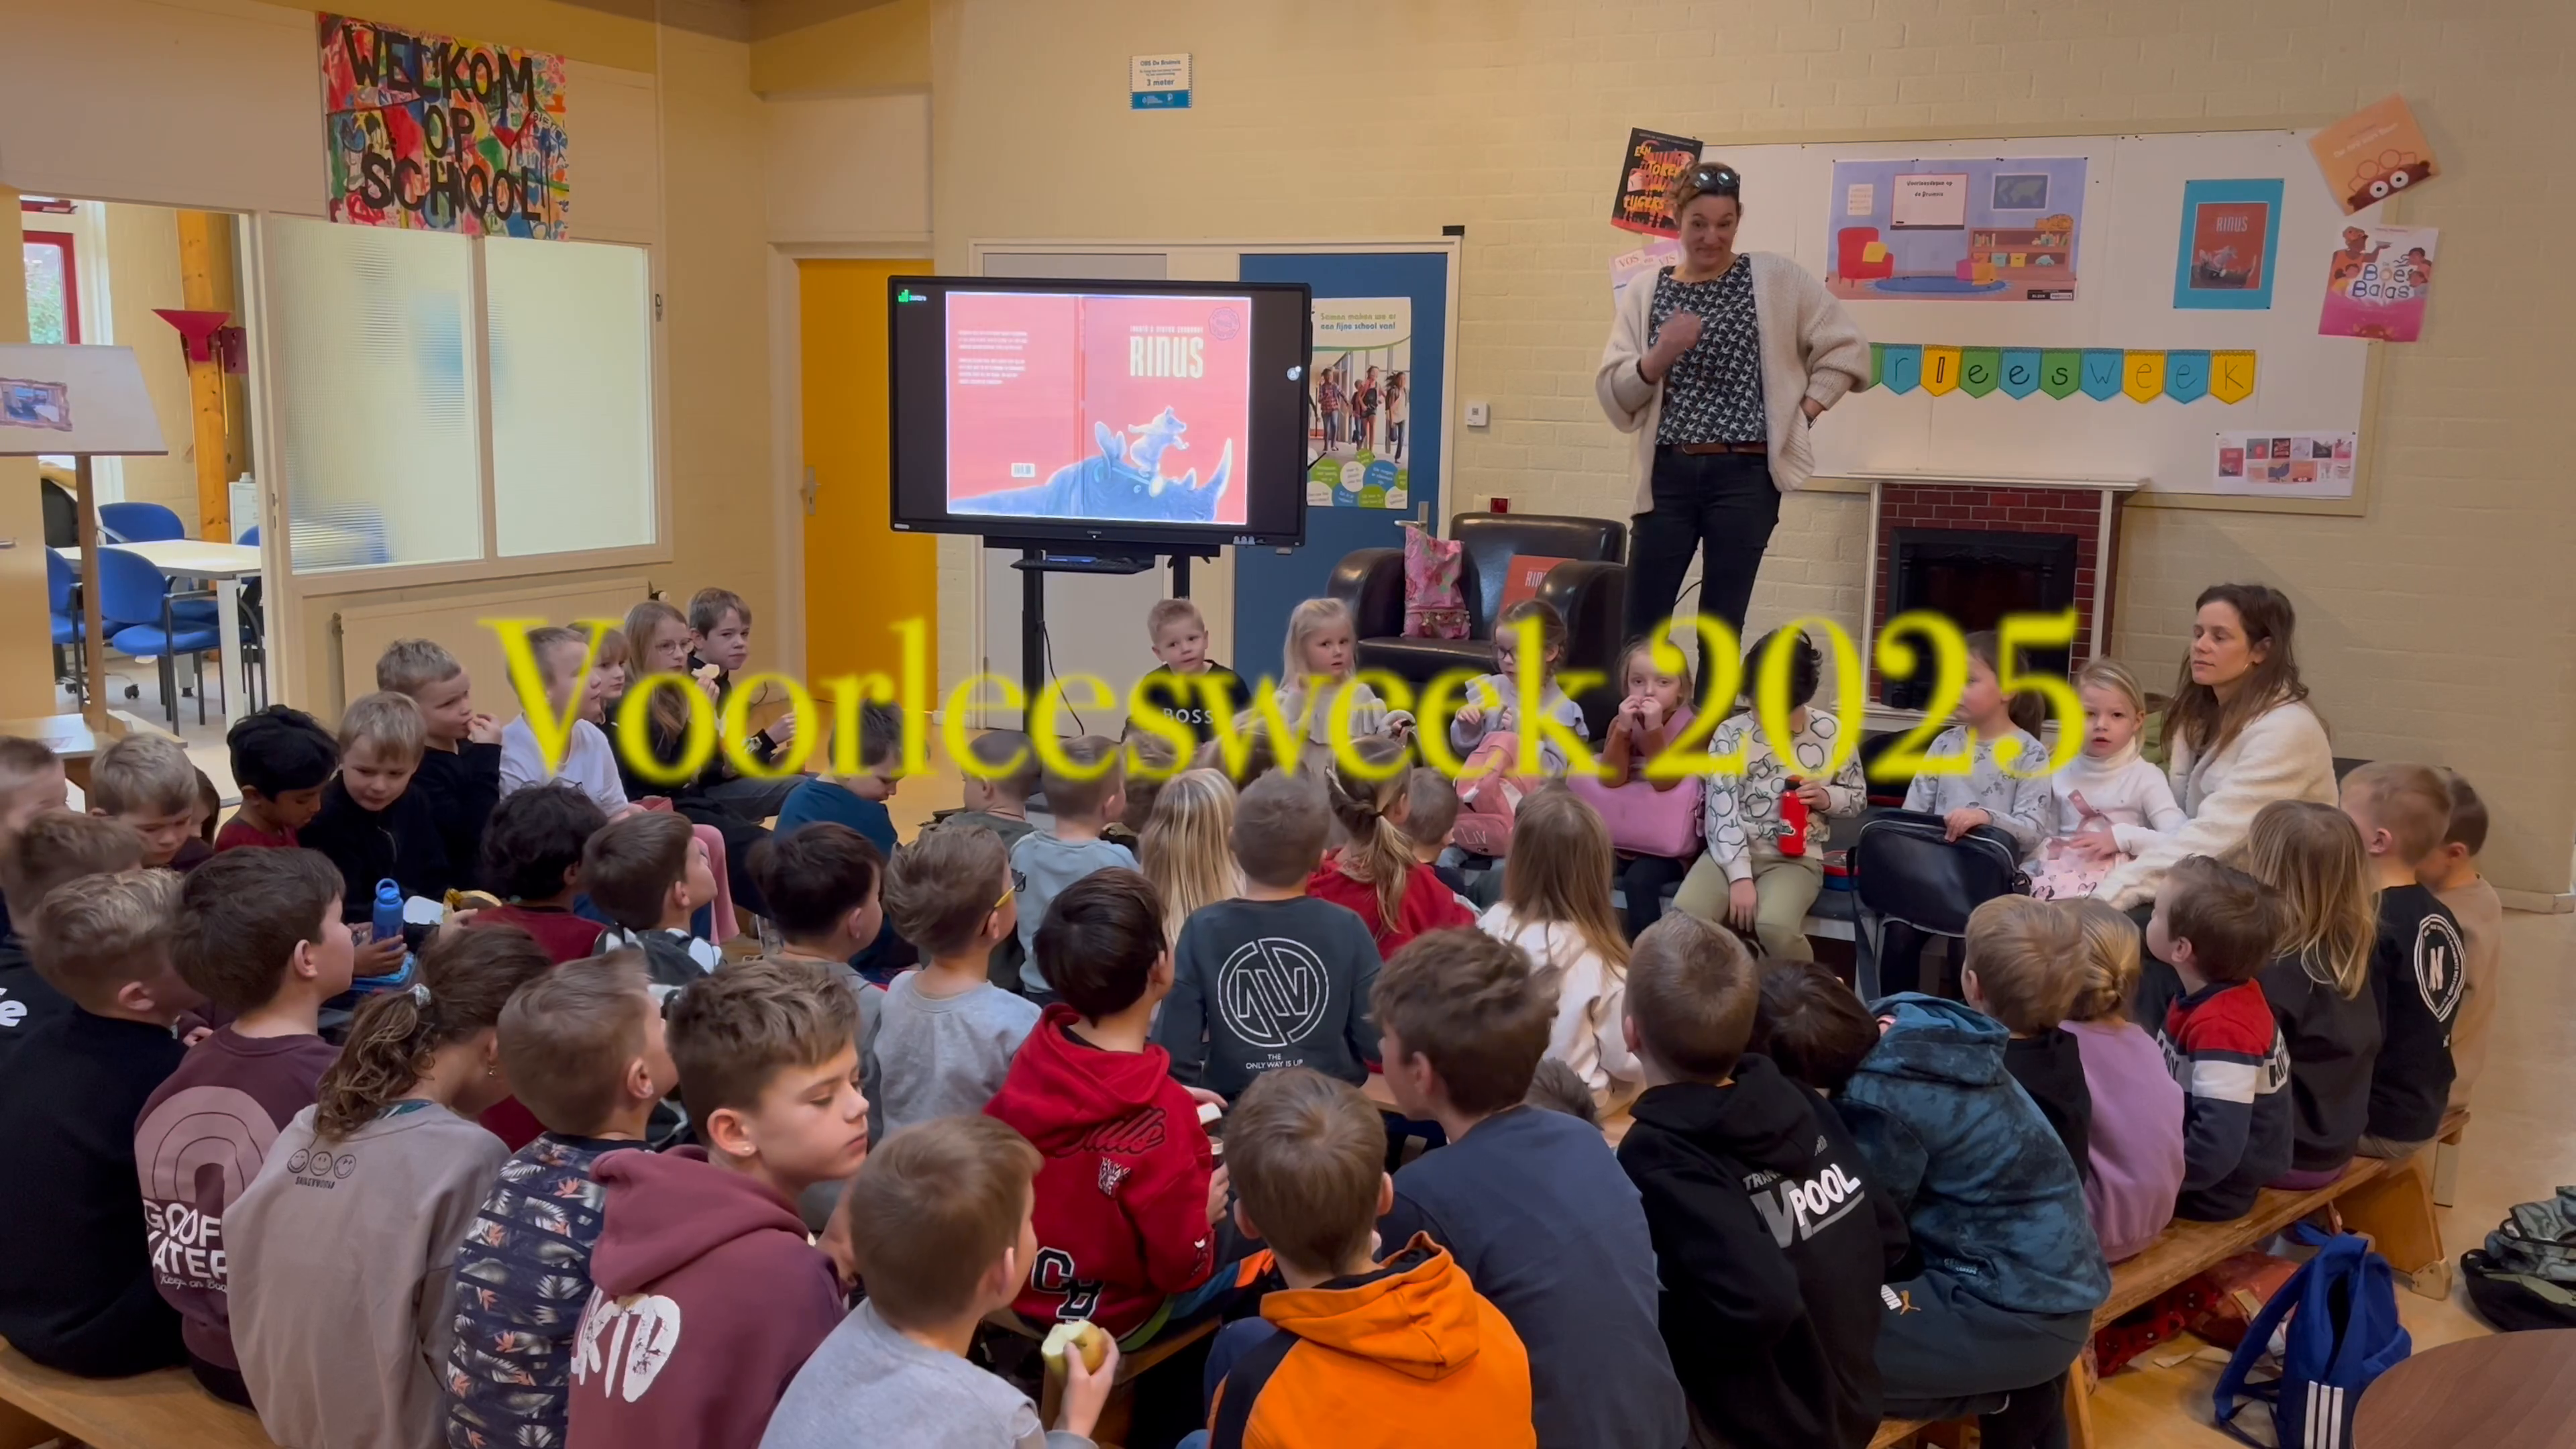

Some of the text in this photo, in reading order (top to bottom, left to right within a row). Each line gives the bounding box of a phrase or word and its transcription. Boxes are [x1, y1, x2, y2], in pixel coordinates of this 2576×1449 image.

[341, 23, 535, 111] WELKOM
[1146, 78, 1151, 87] 3
[423, 105, 476, 162] OP
[1634, 146, 1651, 157] EEN
[360, 152, 541, 221] SCHOOL
[2216, 216, 2248, 232] RINUS
[2352, 280, 2410, 299] Balas
[1130, 336, 1204, 378] RINUS
[1893, 356, 2245, 391] rleesweek
[1525, 570, 1547, 588] RIN
